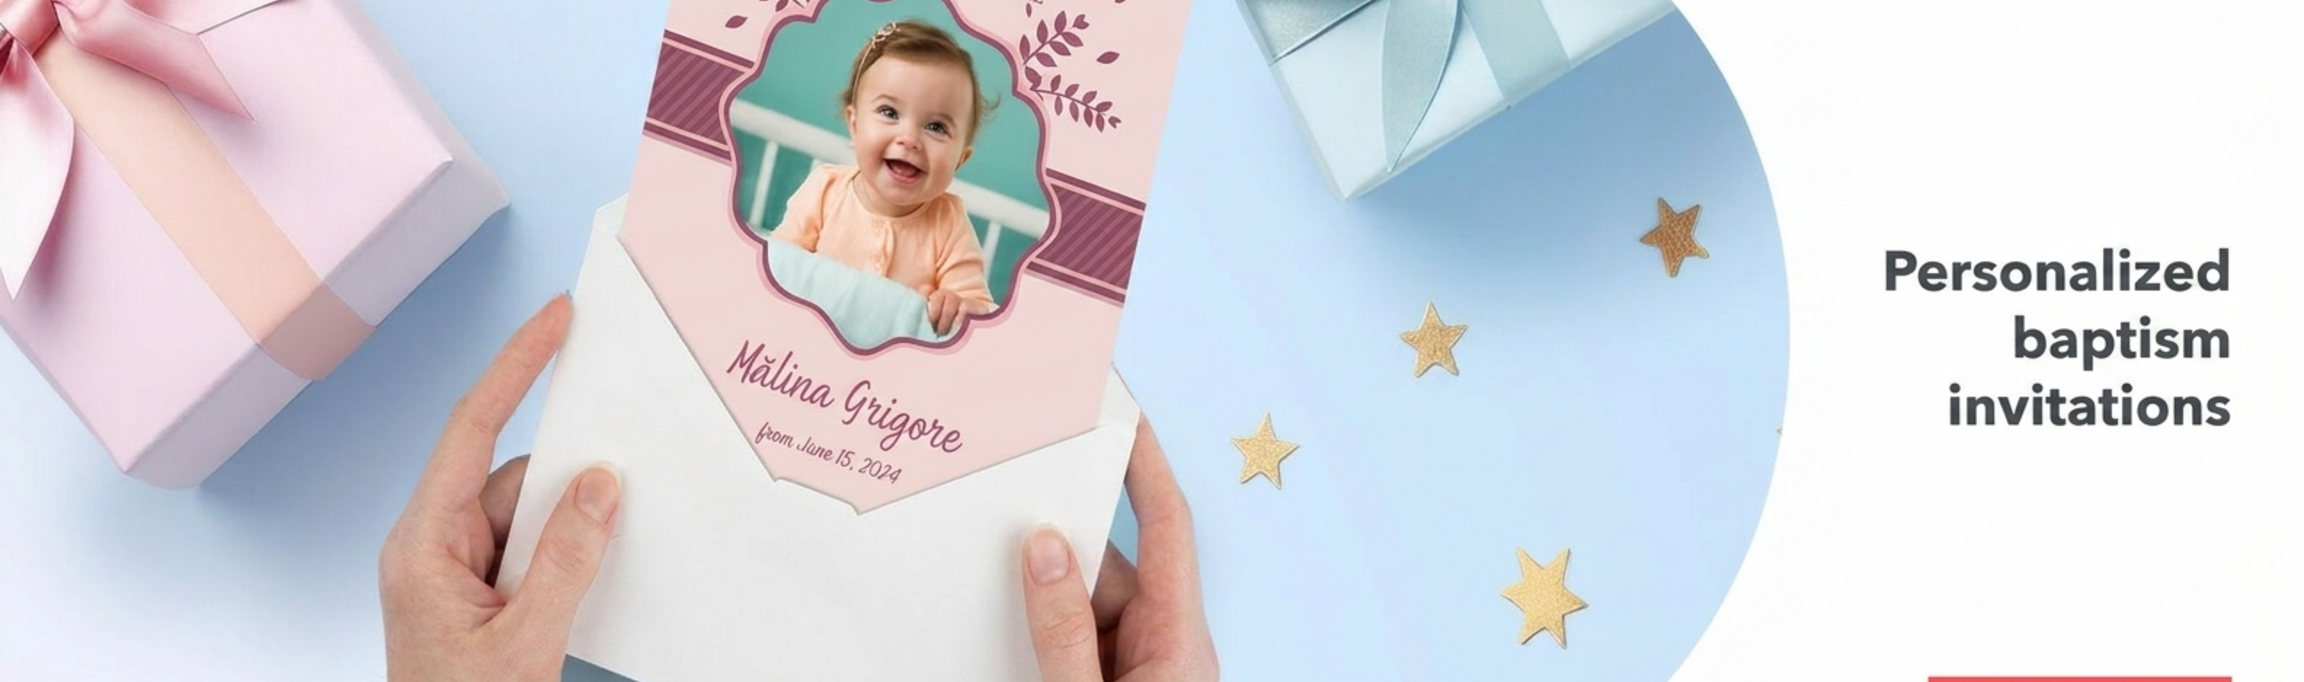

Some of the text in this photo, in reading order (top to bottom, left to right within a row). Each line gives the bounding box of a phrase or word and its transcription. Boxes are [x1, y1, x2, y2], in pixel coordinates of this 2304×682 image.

[726, 339, 963, 453] Mălina Grigore
[754, 421, 794, 448] from
[858, 457, 903, 484] 2024
